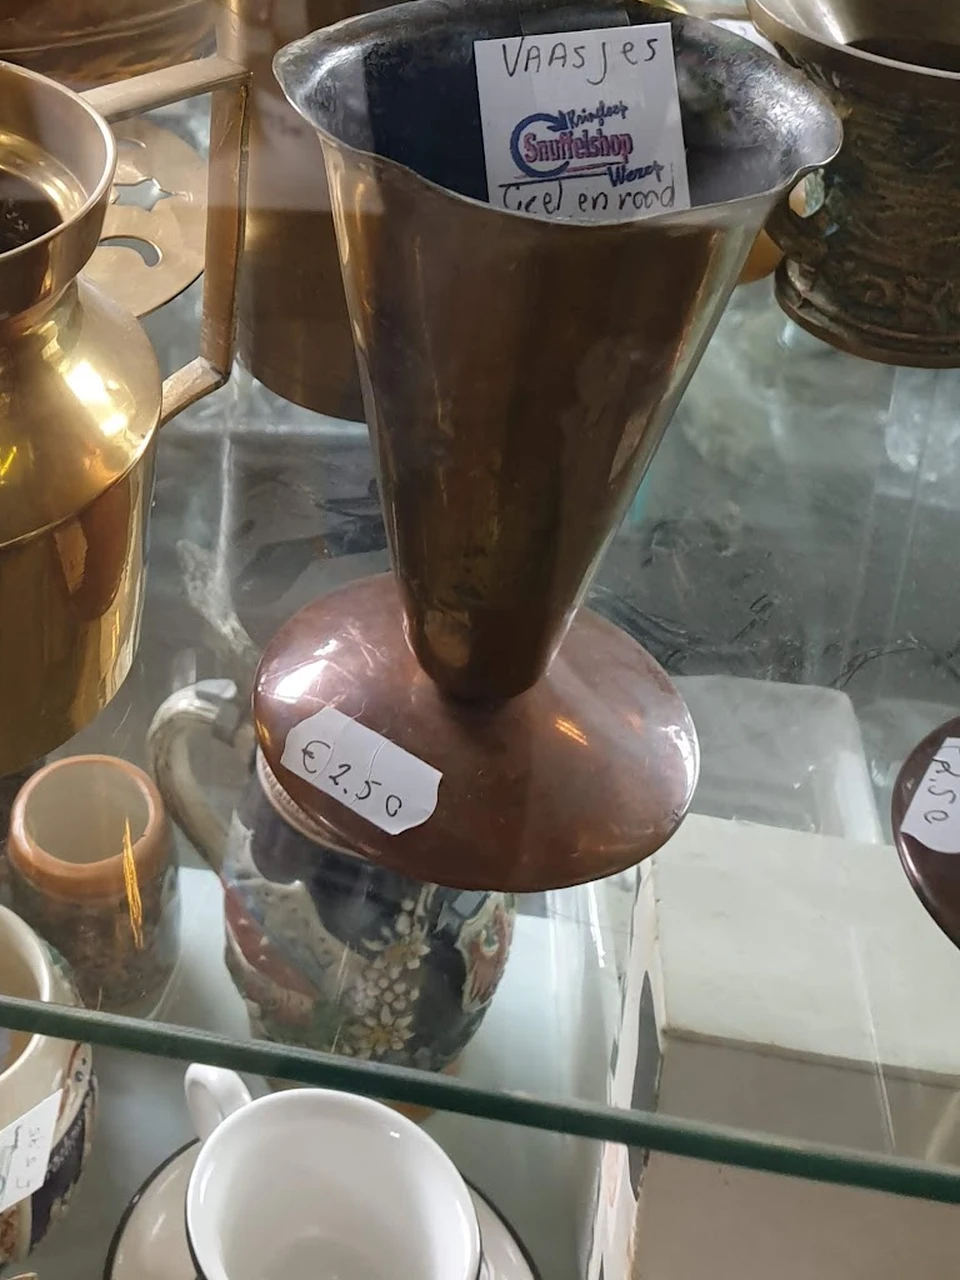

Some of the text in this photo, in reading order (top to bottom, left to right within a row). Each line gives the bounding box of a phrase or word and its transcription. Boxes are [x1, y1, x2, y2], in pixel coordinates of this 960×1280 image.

[523, 128, 634, 165] Snuffelshop
[578, 190, 608, 213] en
[618, 167, 675, 210] rood
